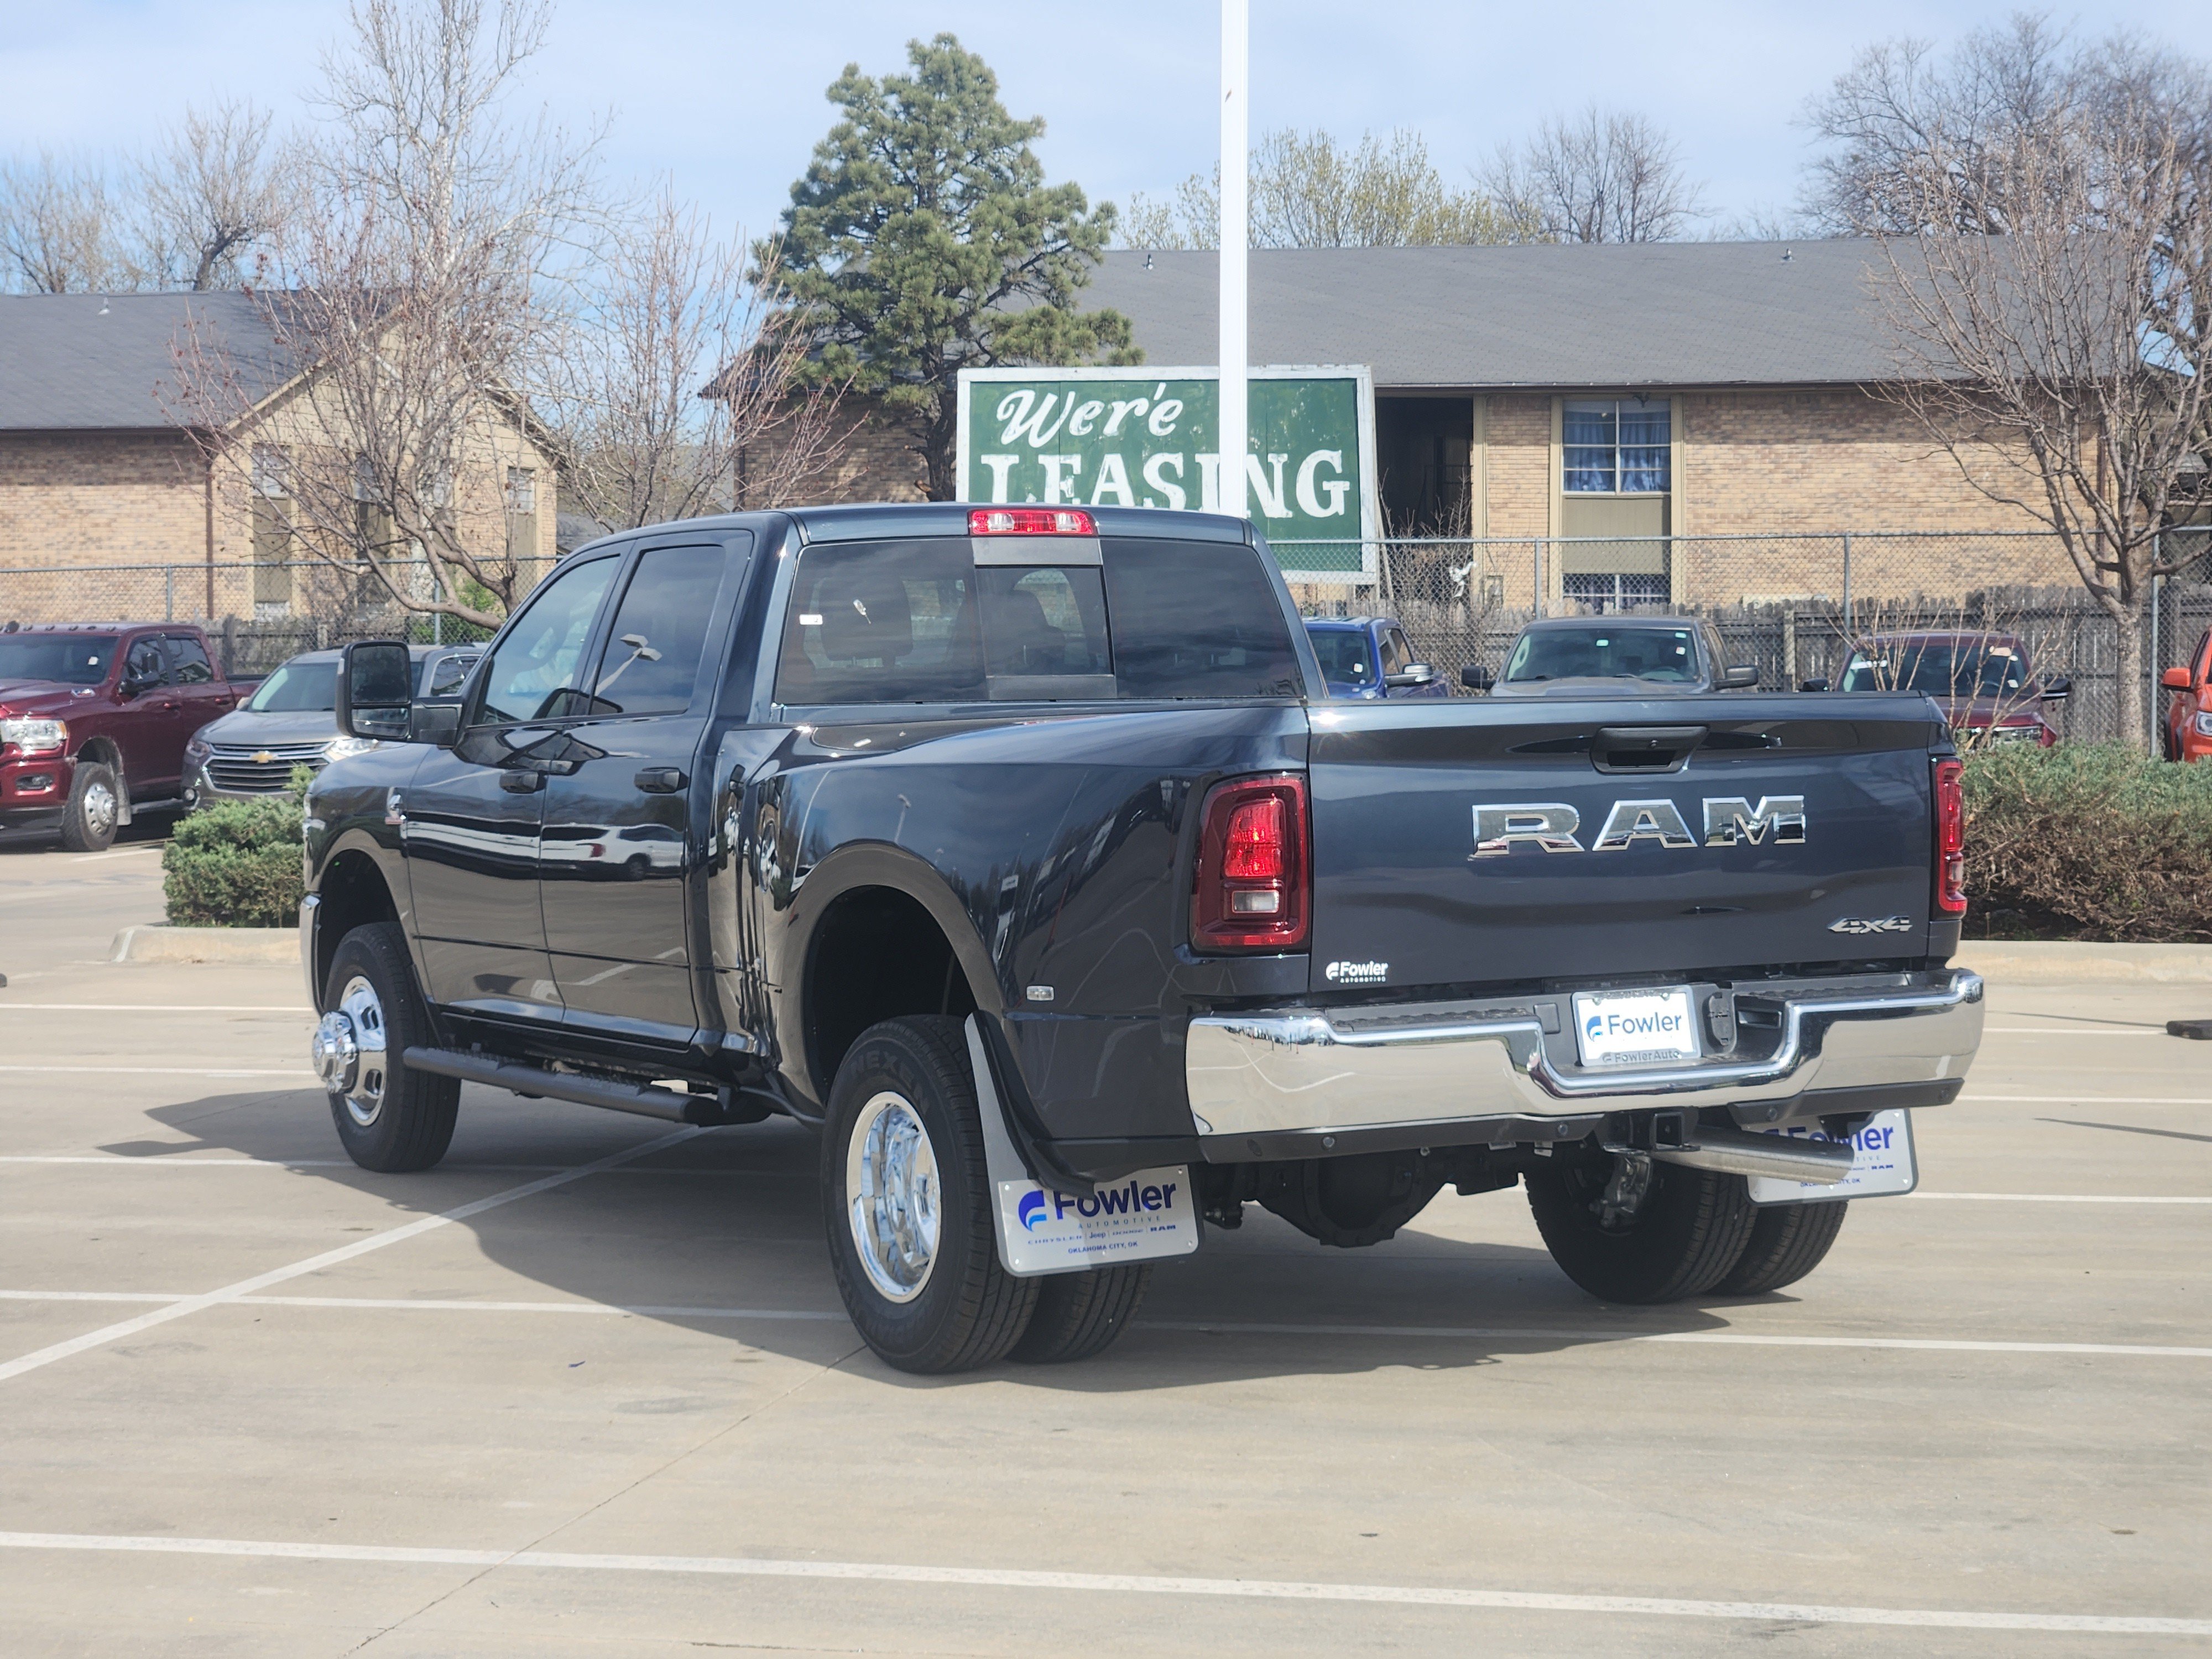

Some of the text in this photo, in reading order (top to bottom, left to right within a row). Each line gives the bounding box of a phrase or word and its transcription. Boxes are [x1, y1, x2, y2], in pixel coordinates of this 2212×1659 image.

[996, 382, 1185, 448] Wer'e
[980, 449, 1350, 519] LEASING
[1472, 795, 1806, 856] RAM
[1340, 961, 1389, 977] Fowler
[1608, 1012, 1682, 1035] Fowler
[1053, 1180, 1177, 1220] Fowler
[1078, 1215, 1161, 1229] AUTOMOTIVE
[1089, 1231, 1106, 1239] Jeep
[1150, 1224, 1176, 1233] RAM
[1068, 1244, 1107, 1254] OKLAHOMA
[1109, 1241, 1126, 1250] CITY,
